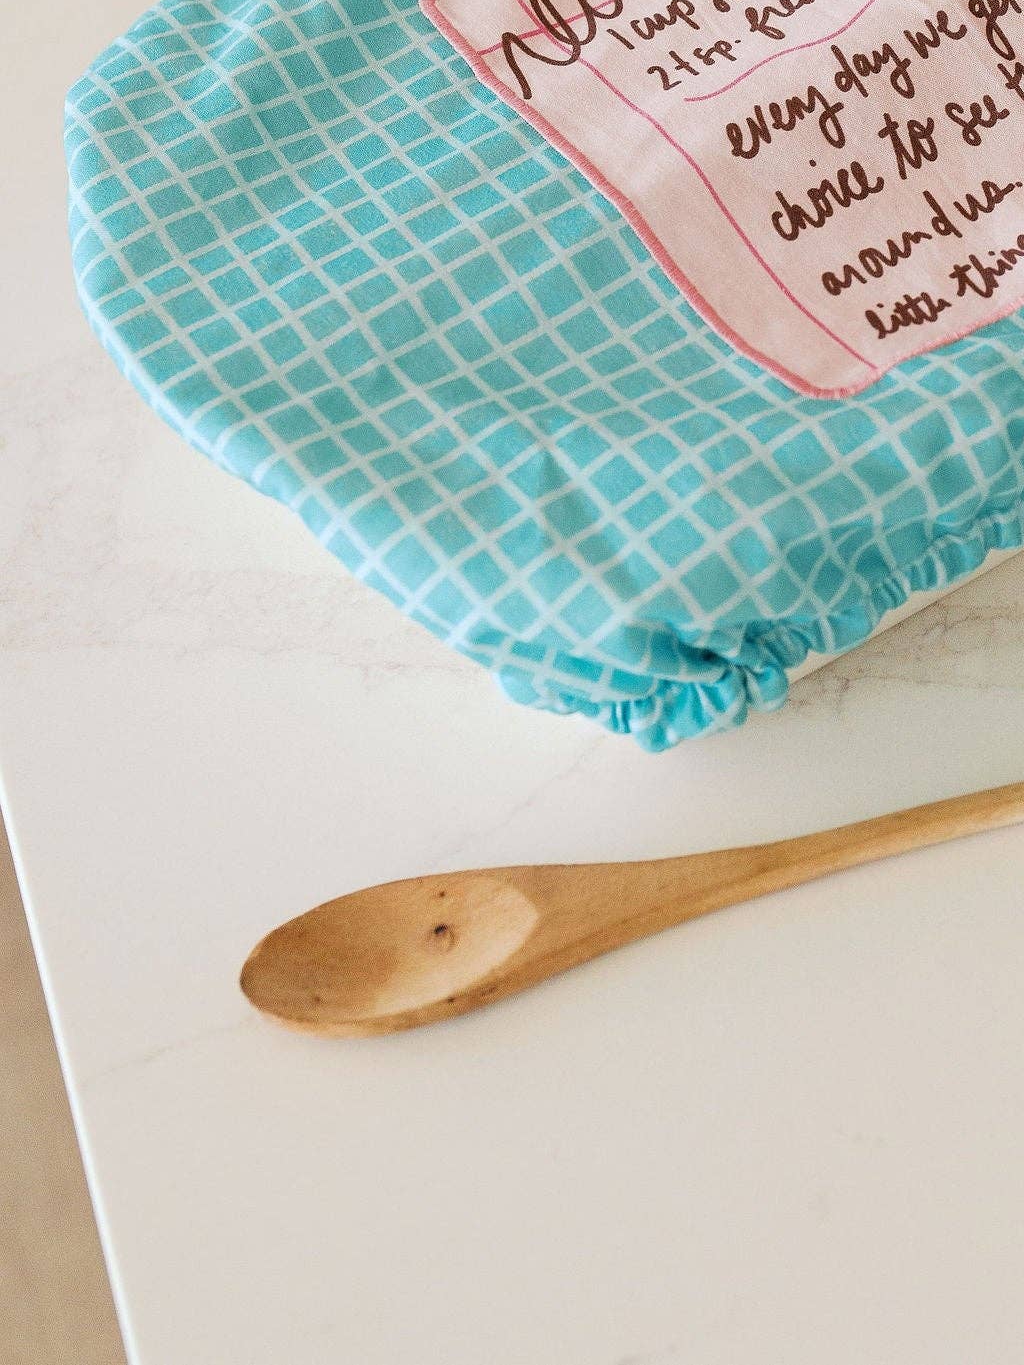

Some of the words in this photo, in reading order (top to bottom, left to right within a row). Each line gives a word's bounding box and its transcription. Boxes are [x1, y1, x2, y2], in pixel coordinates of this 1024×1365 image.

[725, 85, 847, 160] every
[830, 43, 916, 100] day
[902, 9, 968, 60] we
[770, 157, 885, 242] choice
[877, 112, 939, 181] to
[944, 94, 1011, 147] see
[821, 190, 964, 297] around
[952, 179, 1024, 223] us.
[864, 291, 953, 340] little
